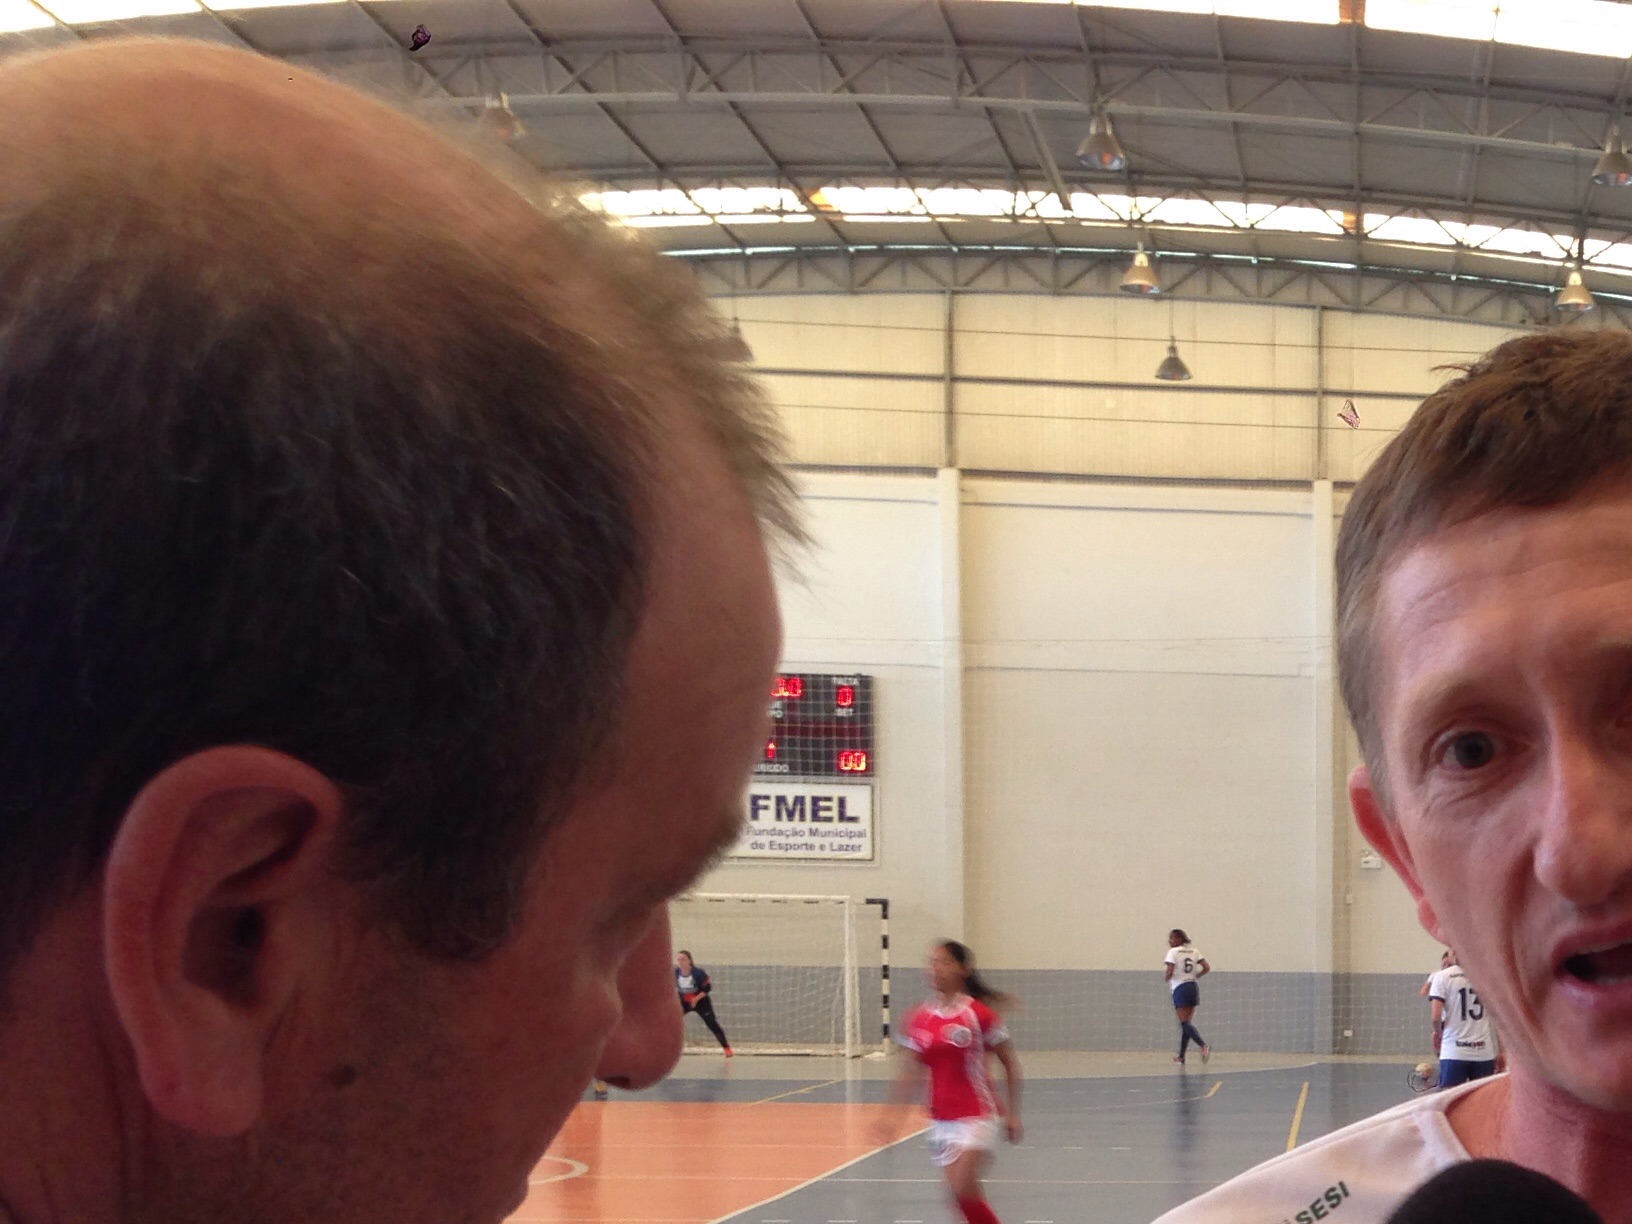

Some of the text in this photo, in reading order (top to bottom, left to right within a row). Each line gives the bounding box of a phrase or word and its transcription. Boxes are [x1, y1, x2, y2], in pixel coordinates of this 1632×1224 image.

[750, 795, 860, 822] FMEL
[809, 828, 867, 838] Municipal
[751, 841, 766, 850] de
[769, 842, 816, 851] Esporte
[831, 842, 862, 852] Lazer
[1184, 957, 1194, 974] 6
[1458, 987, 1484, 1021] 13
